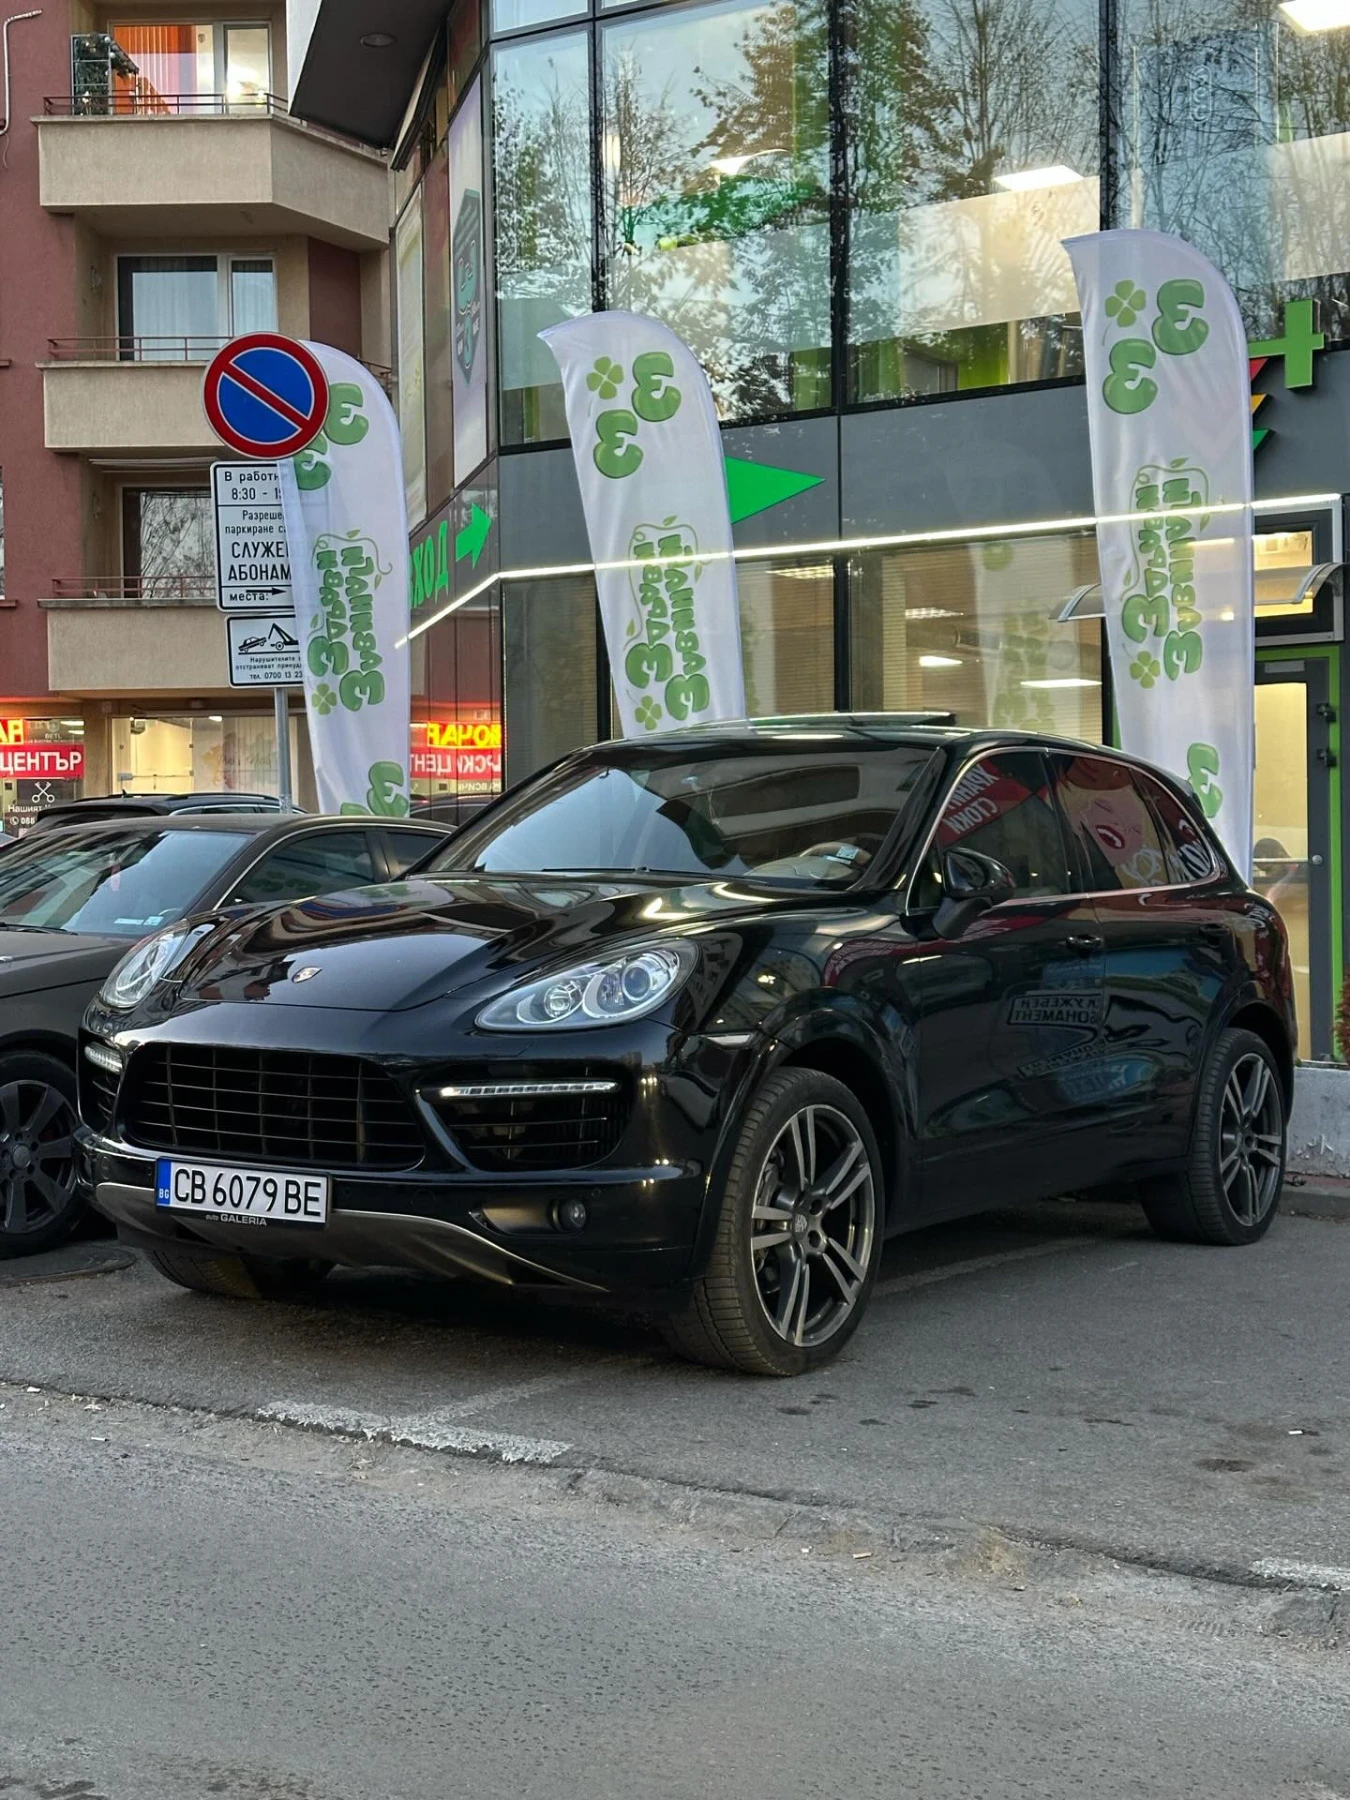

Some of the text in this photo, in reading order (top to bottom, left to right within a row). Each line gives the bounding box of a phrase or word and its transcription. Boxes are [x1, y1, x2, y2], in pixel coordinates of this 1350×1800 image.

[224, 471, 232, 482] В
[231, 487, 256, 500] 8:30
[242, 509, 285, 522] Разреше
[225, 525, 274, 536] паркиране
[231, 541, 289, 559] СЛУЖЕ
[229, 592, 269, 601] места:
[0, 751, 82, 775] ЦЕНТЪР
[158, 1188, 170, 1200] BG
[212, 1172, 278, 1212] 6079
[220, 1213, 268, 1226] GALERIA
